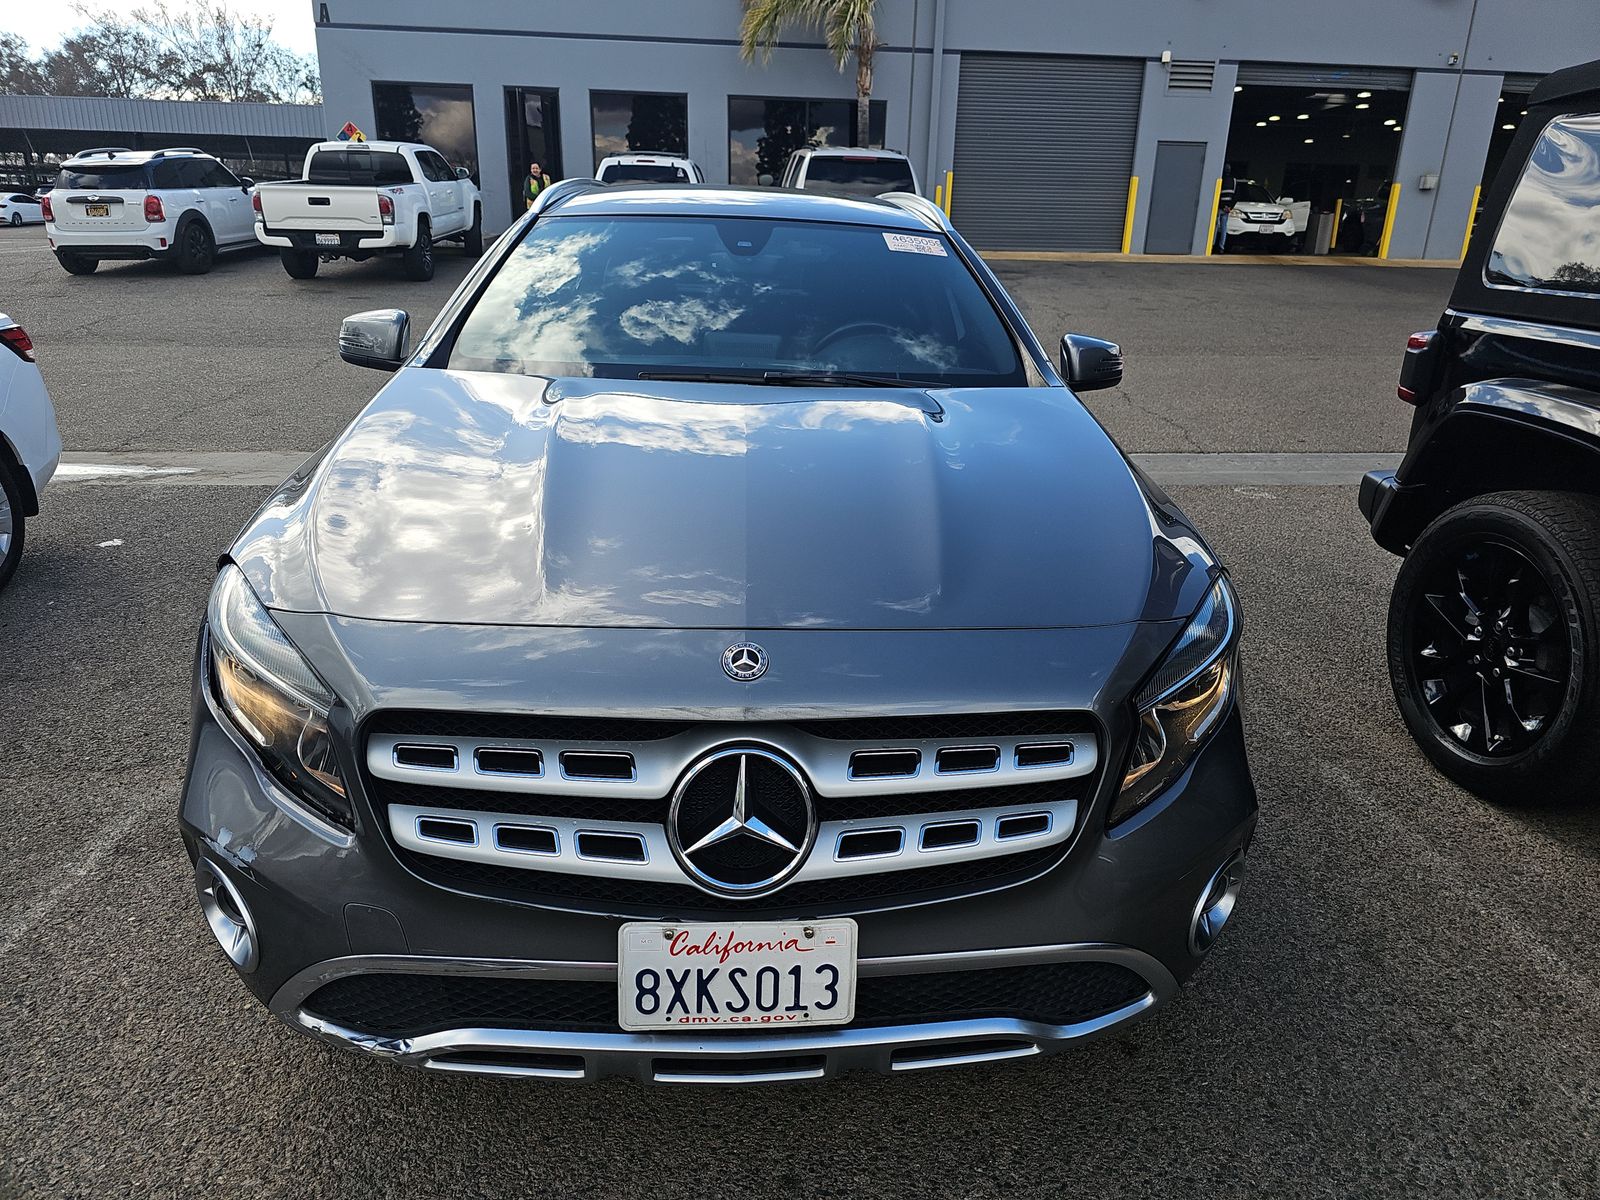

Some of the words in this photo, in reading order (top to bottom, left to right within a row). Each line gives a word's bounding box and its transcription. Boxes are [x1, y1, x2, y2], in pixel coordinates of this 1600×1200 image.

[319, 3, 331, 23] A
[669, 930, 815, 963] California
[635, 963, 840, 1015] 8XKS013
[677, 1013, 798, 1024] dmv.ca.gov
